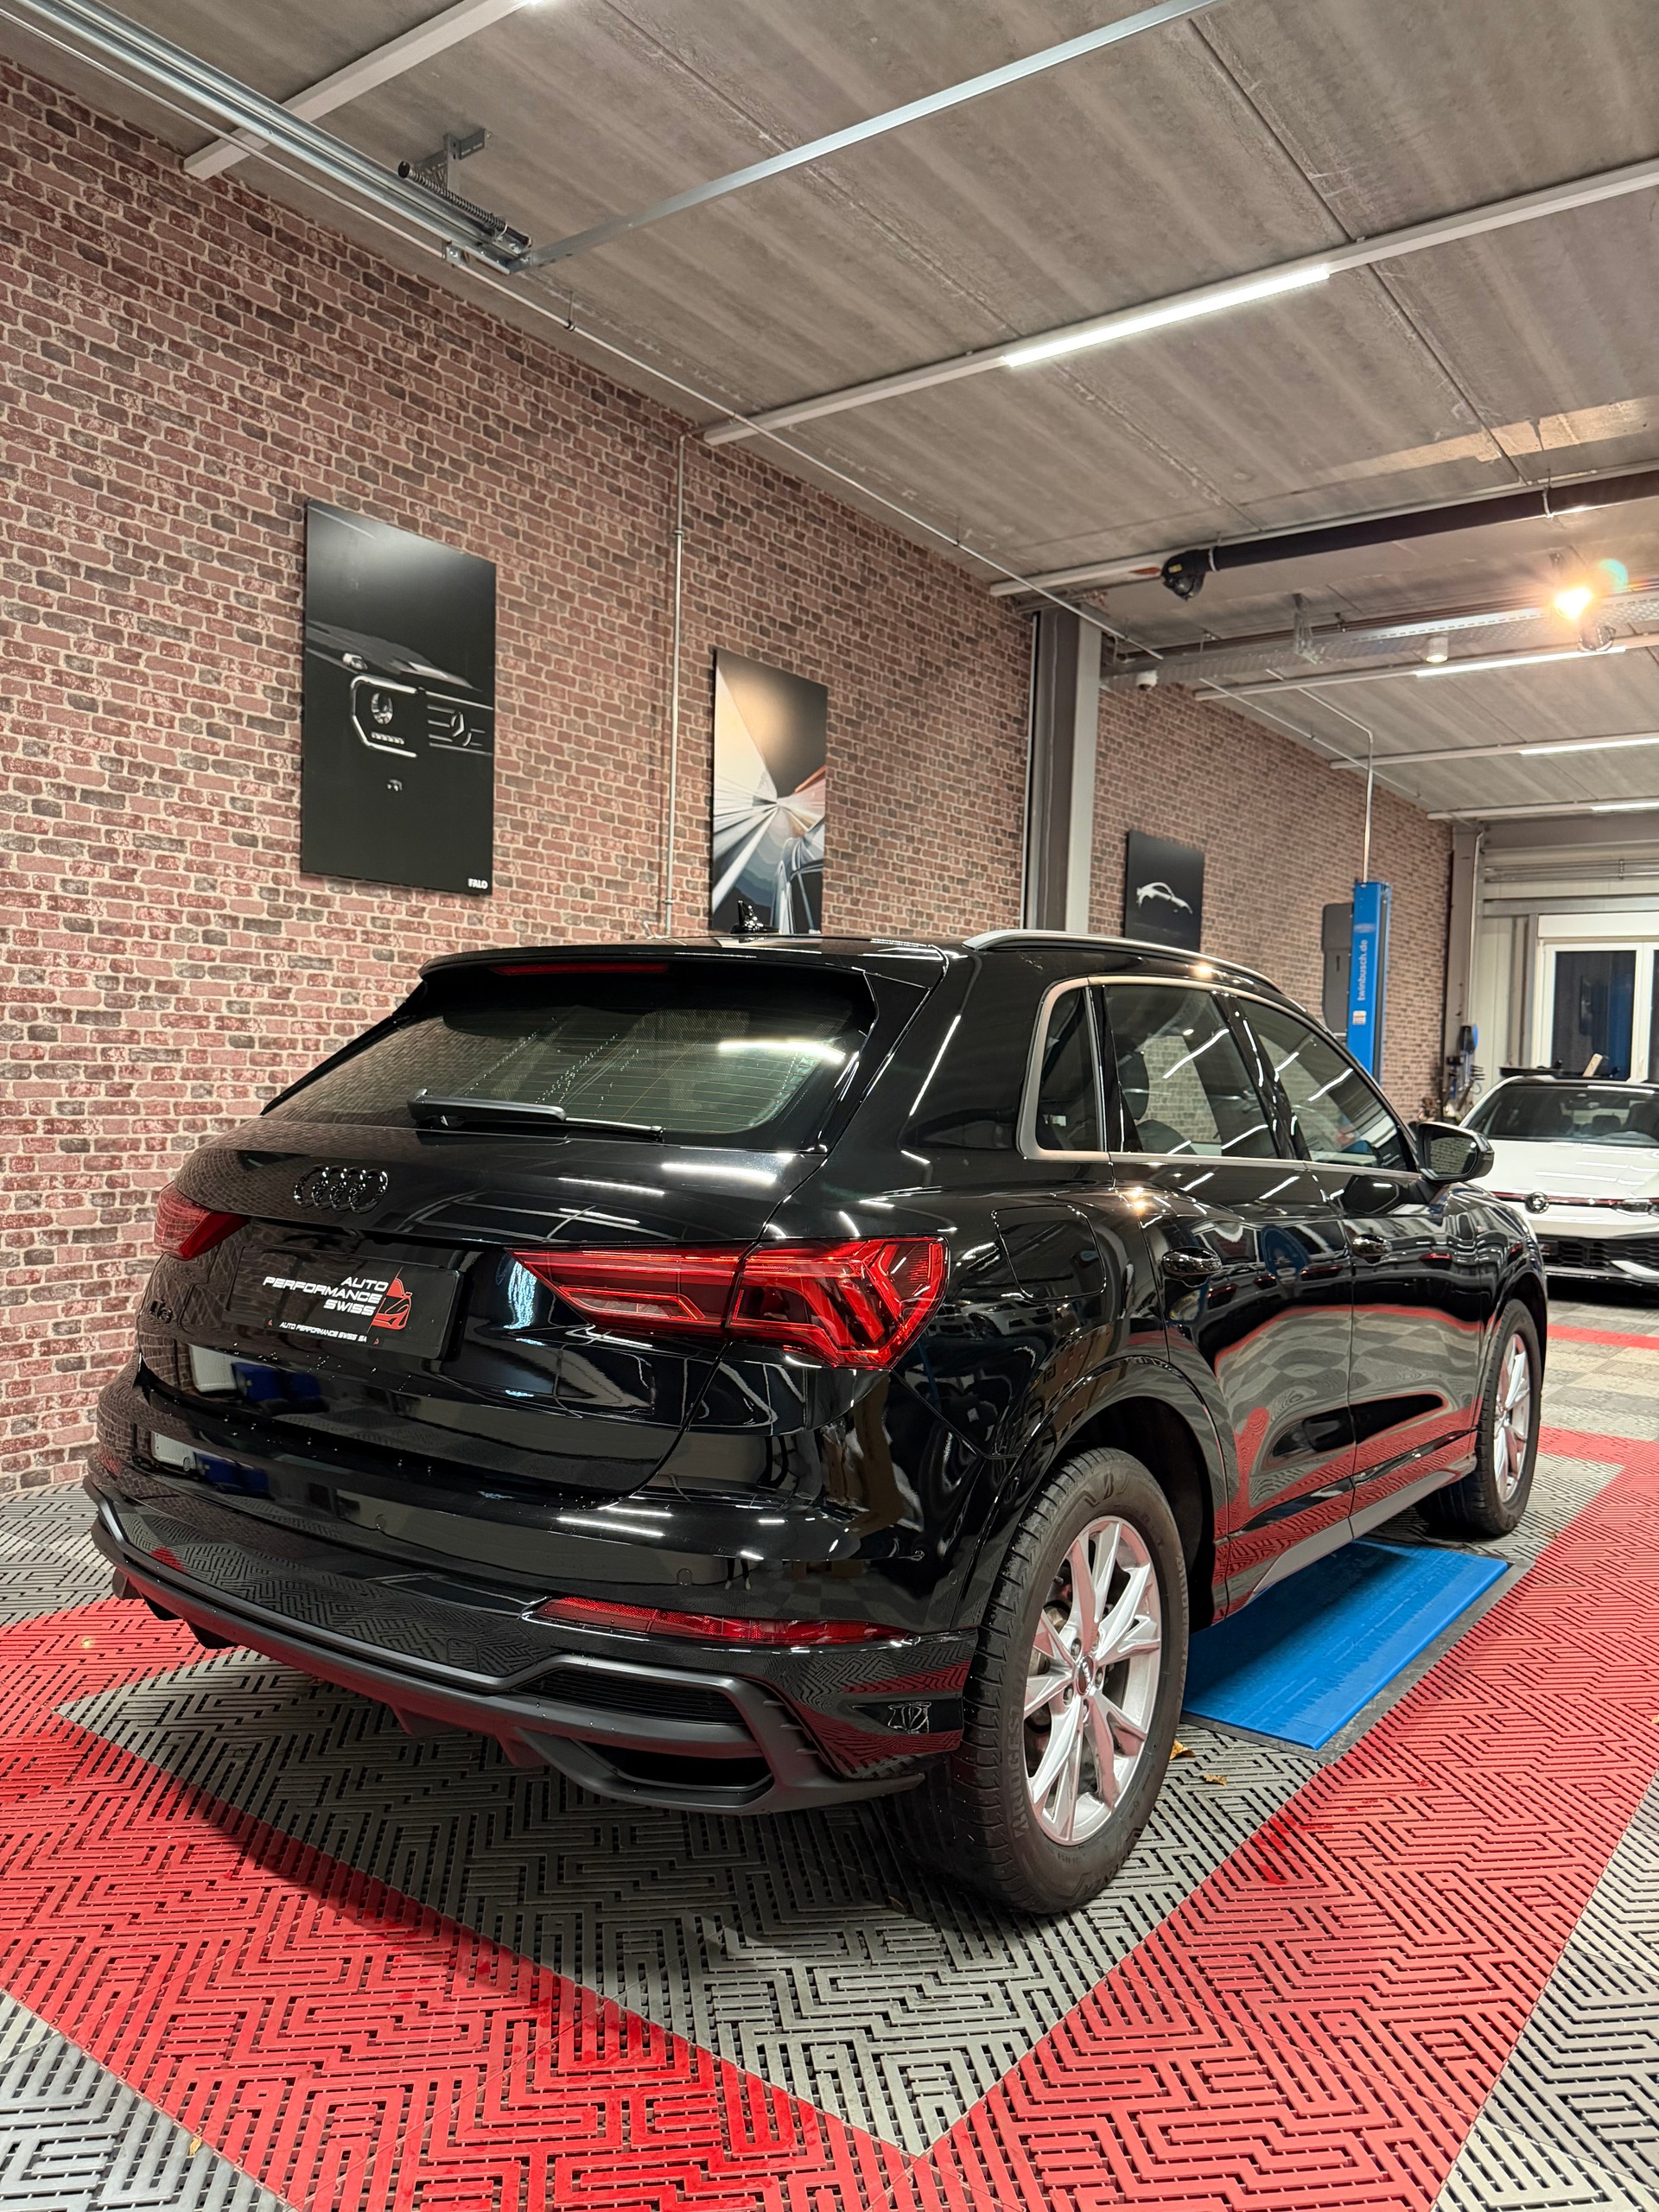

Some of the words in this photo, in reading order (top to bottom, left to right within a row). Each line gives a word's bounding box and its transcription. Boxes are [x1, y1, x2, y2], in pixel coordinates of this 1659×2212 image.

[467, 878, 488, 890] FALO
[1357, 939, 1368, 1001] twinbusch.de
[263, 1276, 383, 1304] PERFORMANCE
[340, 1276, 389, 1292] AUTO
[324, 1299, 377, 1316] SWISS
[279, 1322, 296, 1331] AUTO
[296, 1324, 339, 1338] PERFORMANCE
[339, 1332, 358, 1341] SWISS
